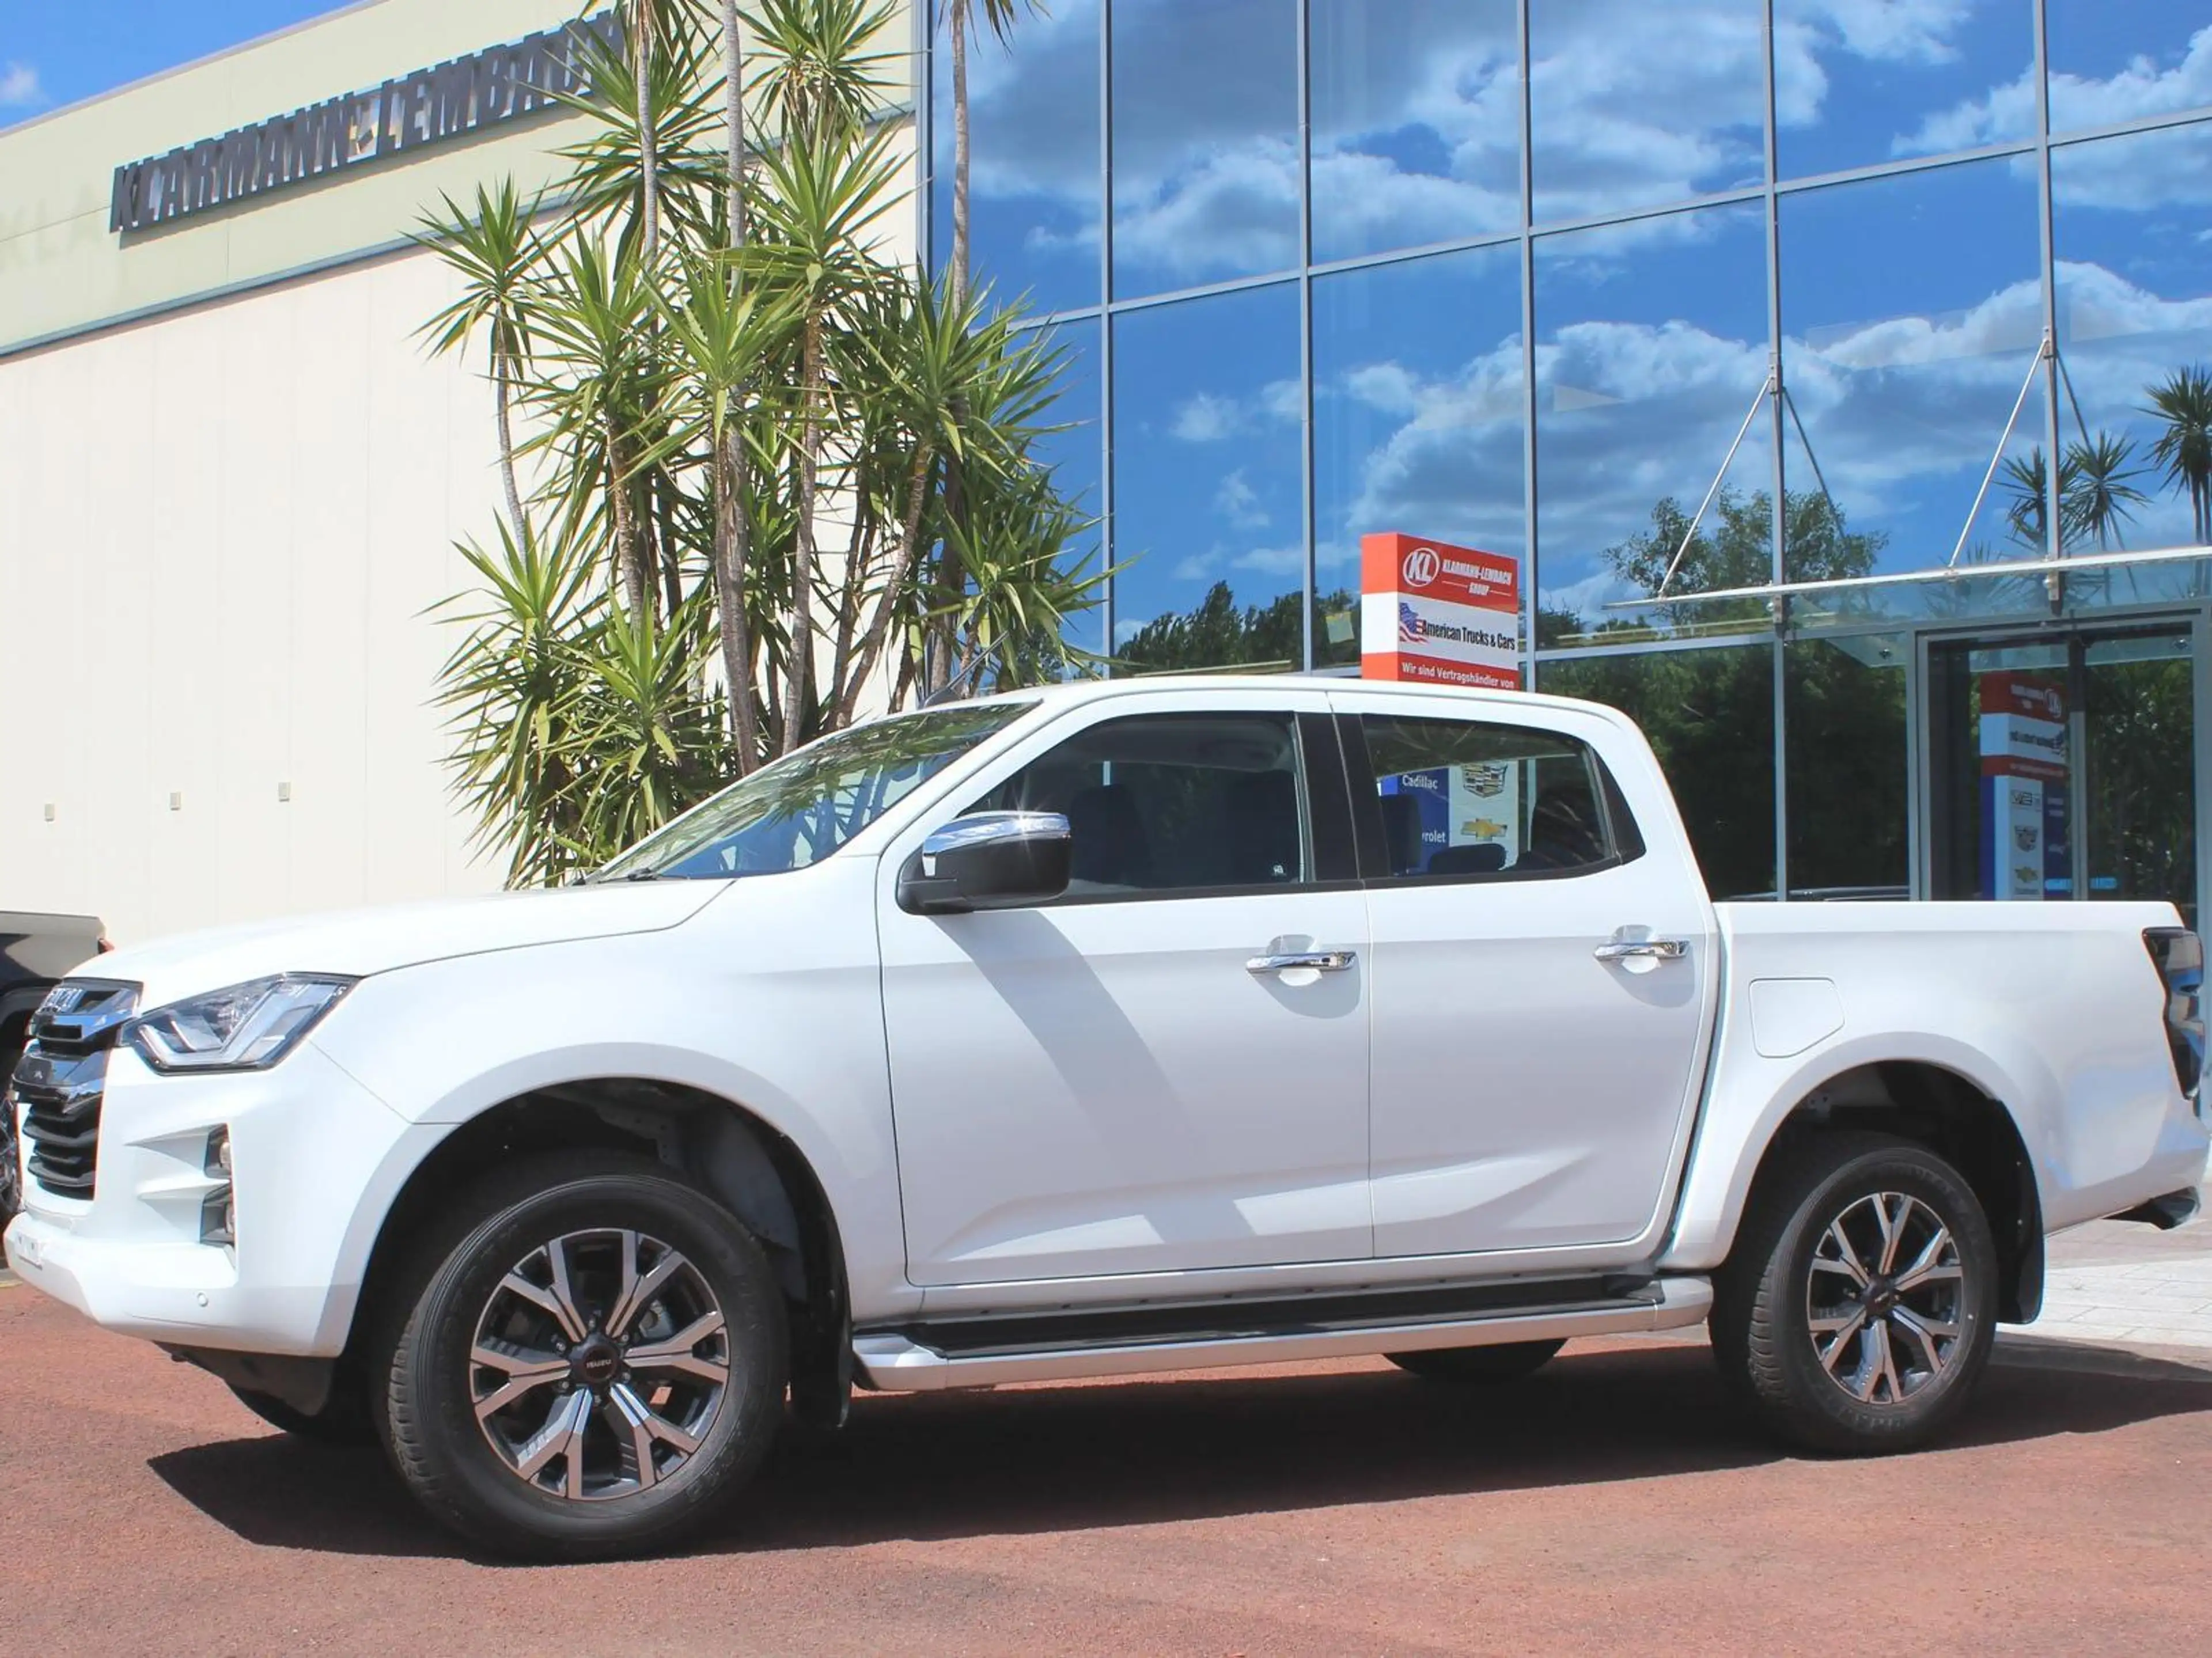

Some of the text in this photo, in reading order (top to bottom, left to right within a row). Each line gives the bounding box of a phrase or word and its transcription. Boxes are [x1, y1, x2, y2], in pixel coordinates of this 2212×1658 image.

[1422, 619, 1516, 650] American Trucks & Cars
[1402, 662, 1416, 674] Wir
[1418, 663, 1435, 677] sind
[1500, 680, 1514, 689] von
[1402, 774, 1438, 790] Cadillac
[1422, 829, 1445, 843] rolet
